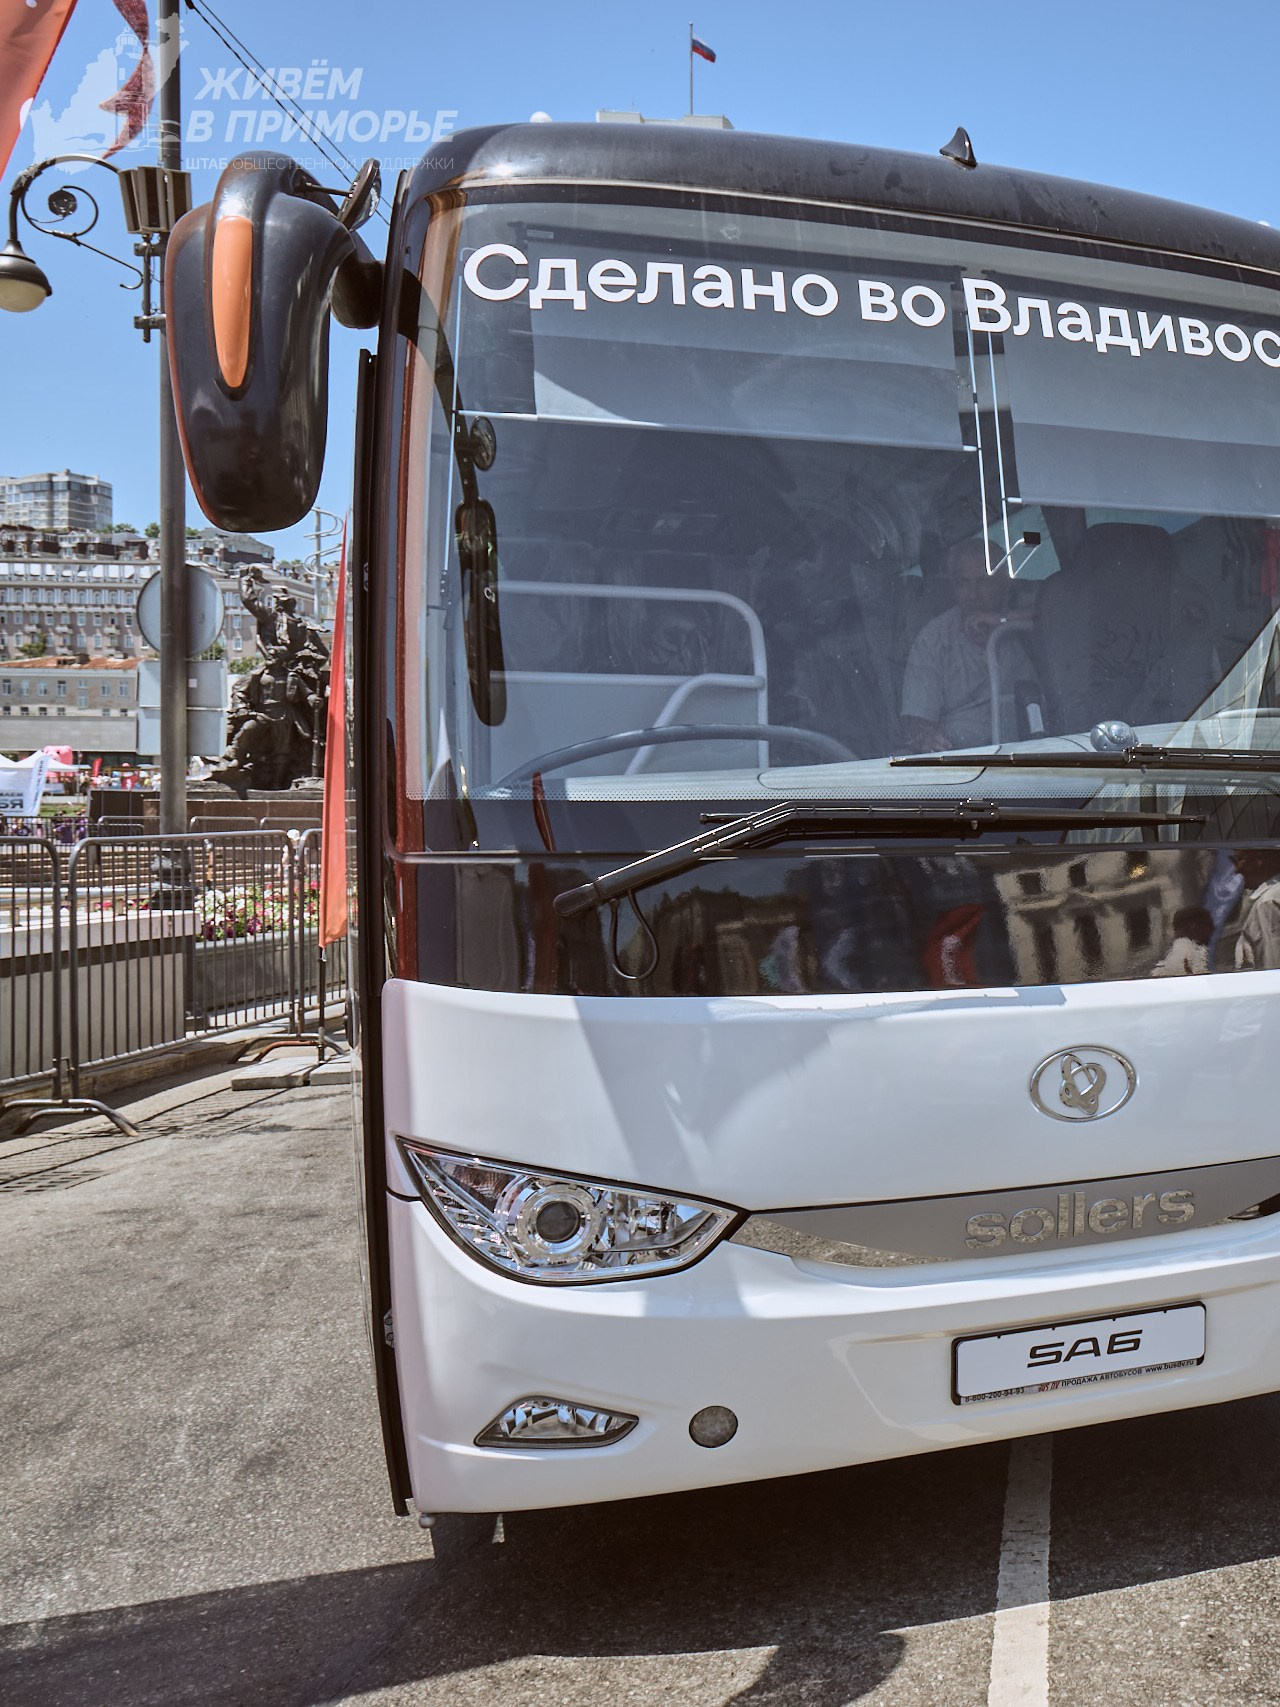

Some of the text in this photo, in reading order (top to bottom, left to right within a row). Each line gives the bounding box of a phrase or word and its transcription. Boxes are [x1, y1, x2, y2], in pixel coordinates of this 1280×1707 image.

[463, 243, 839, 311] Сделано
[858, 279, 946, 327] во
[966, 1189, 1195, 1249] sollers
[1027, 1329, 1144, 1369] SA6
[1061, 1376, 1098, 1388] ПРОДАЖА
[1100, 1368, 1143, 1382] АВТОБУСОВ
[1145, 1359, 1194, 1374] www.busdv.ru
